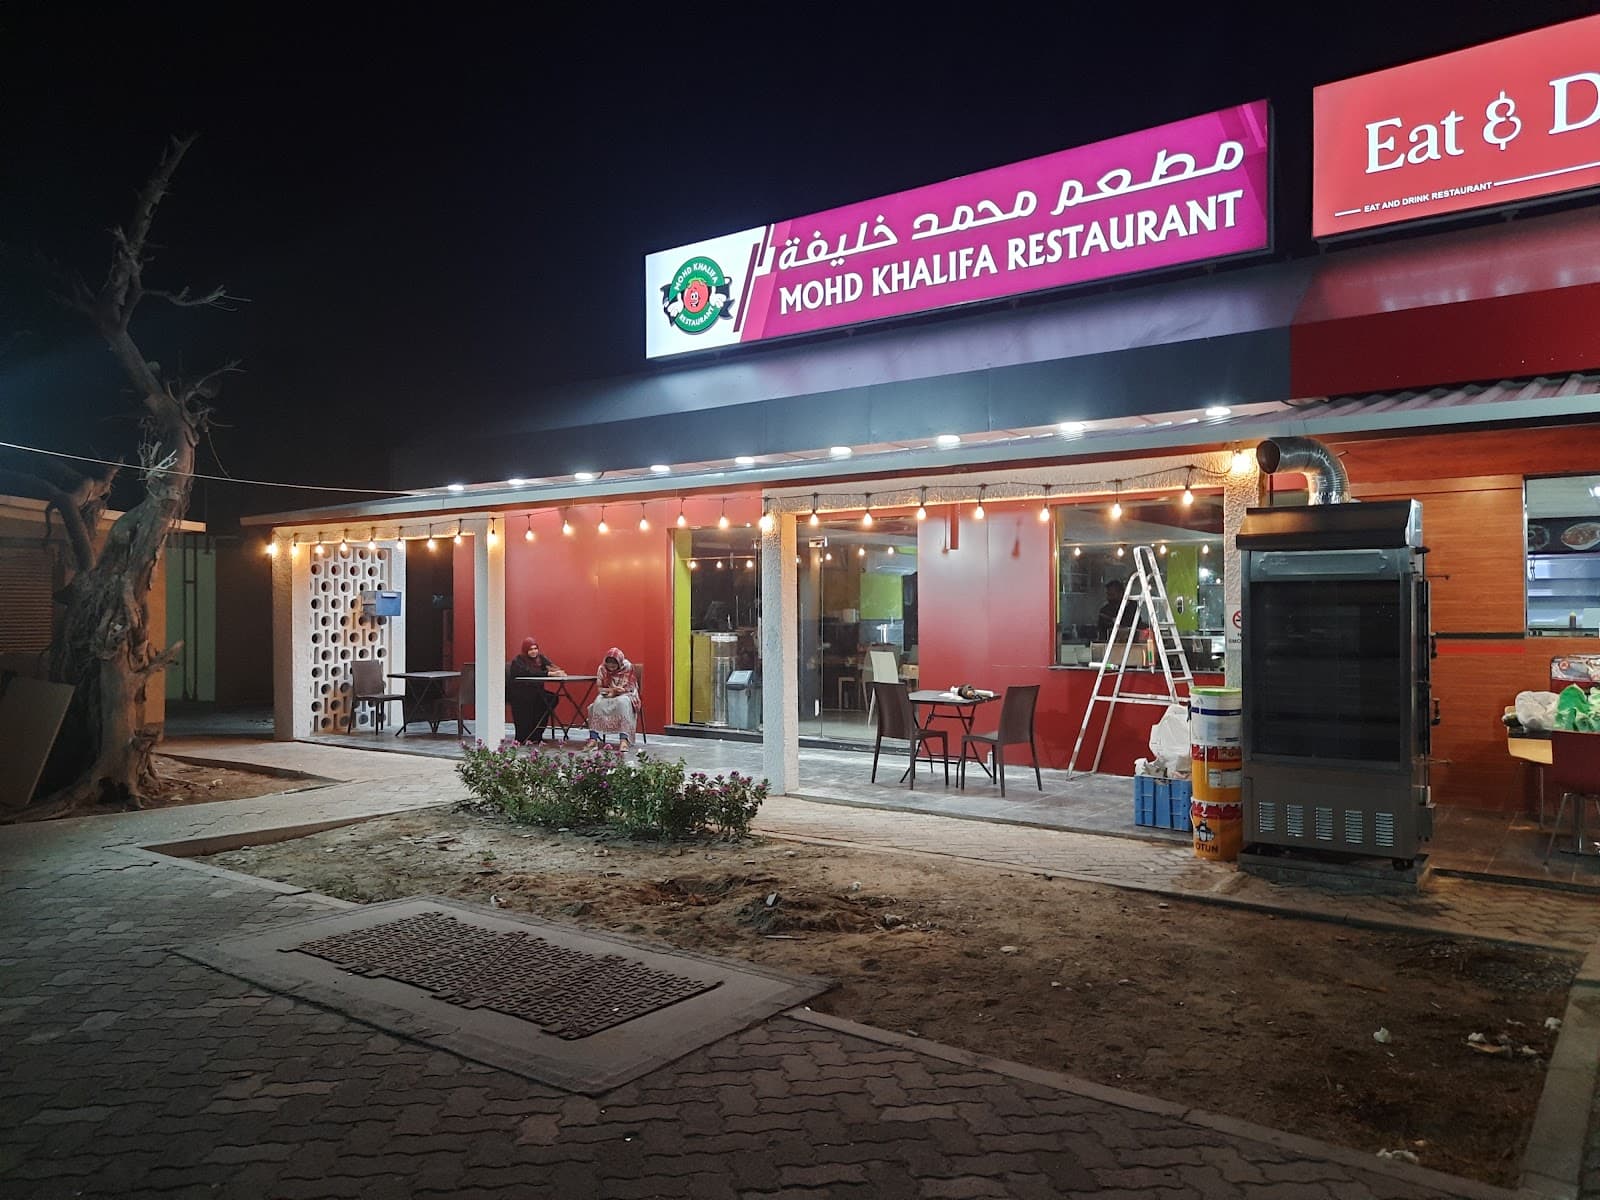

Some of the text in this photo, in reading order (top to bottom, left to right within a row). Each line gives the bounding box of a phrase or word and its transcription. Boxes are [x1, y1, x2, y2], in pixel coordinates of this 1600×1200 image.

[1364, 109, 1465, 174] Eat
[1482, 90, 1522, 151] &
[778, 140, 1244, 270] مطعم محمد خليفة
[1363, 181, 1493, 213] EAT AND DRINK RESTAURANT
[673, 262, 718, 291] MOHD KHALIFA
[779, 189, 1244, 315] MOHD KHALIFA RESTAURANT
[678, 305, 715, 327] RESTAURANT
